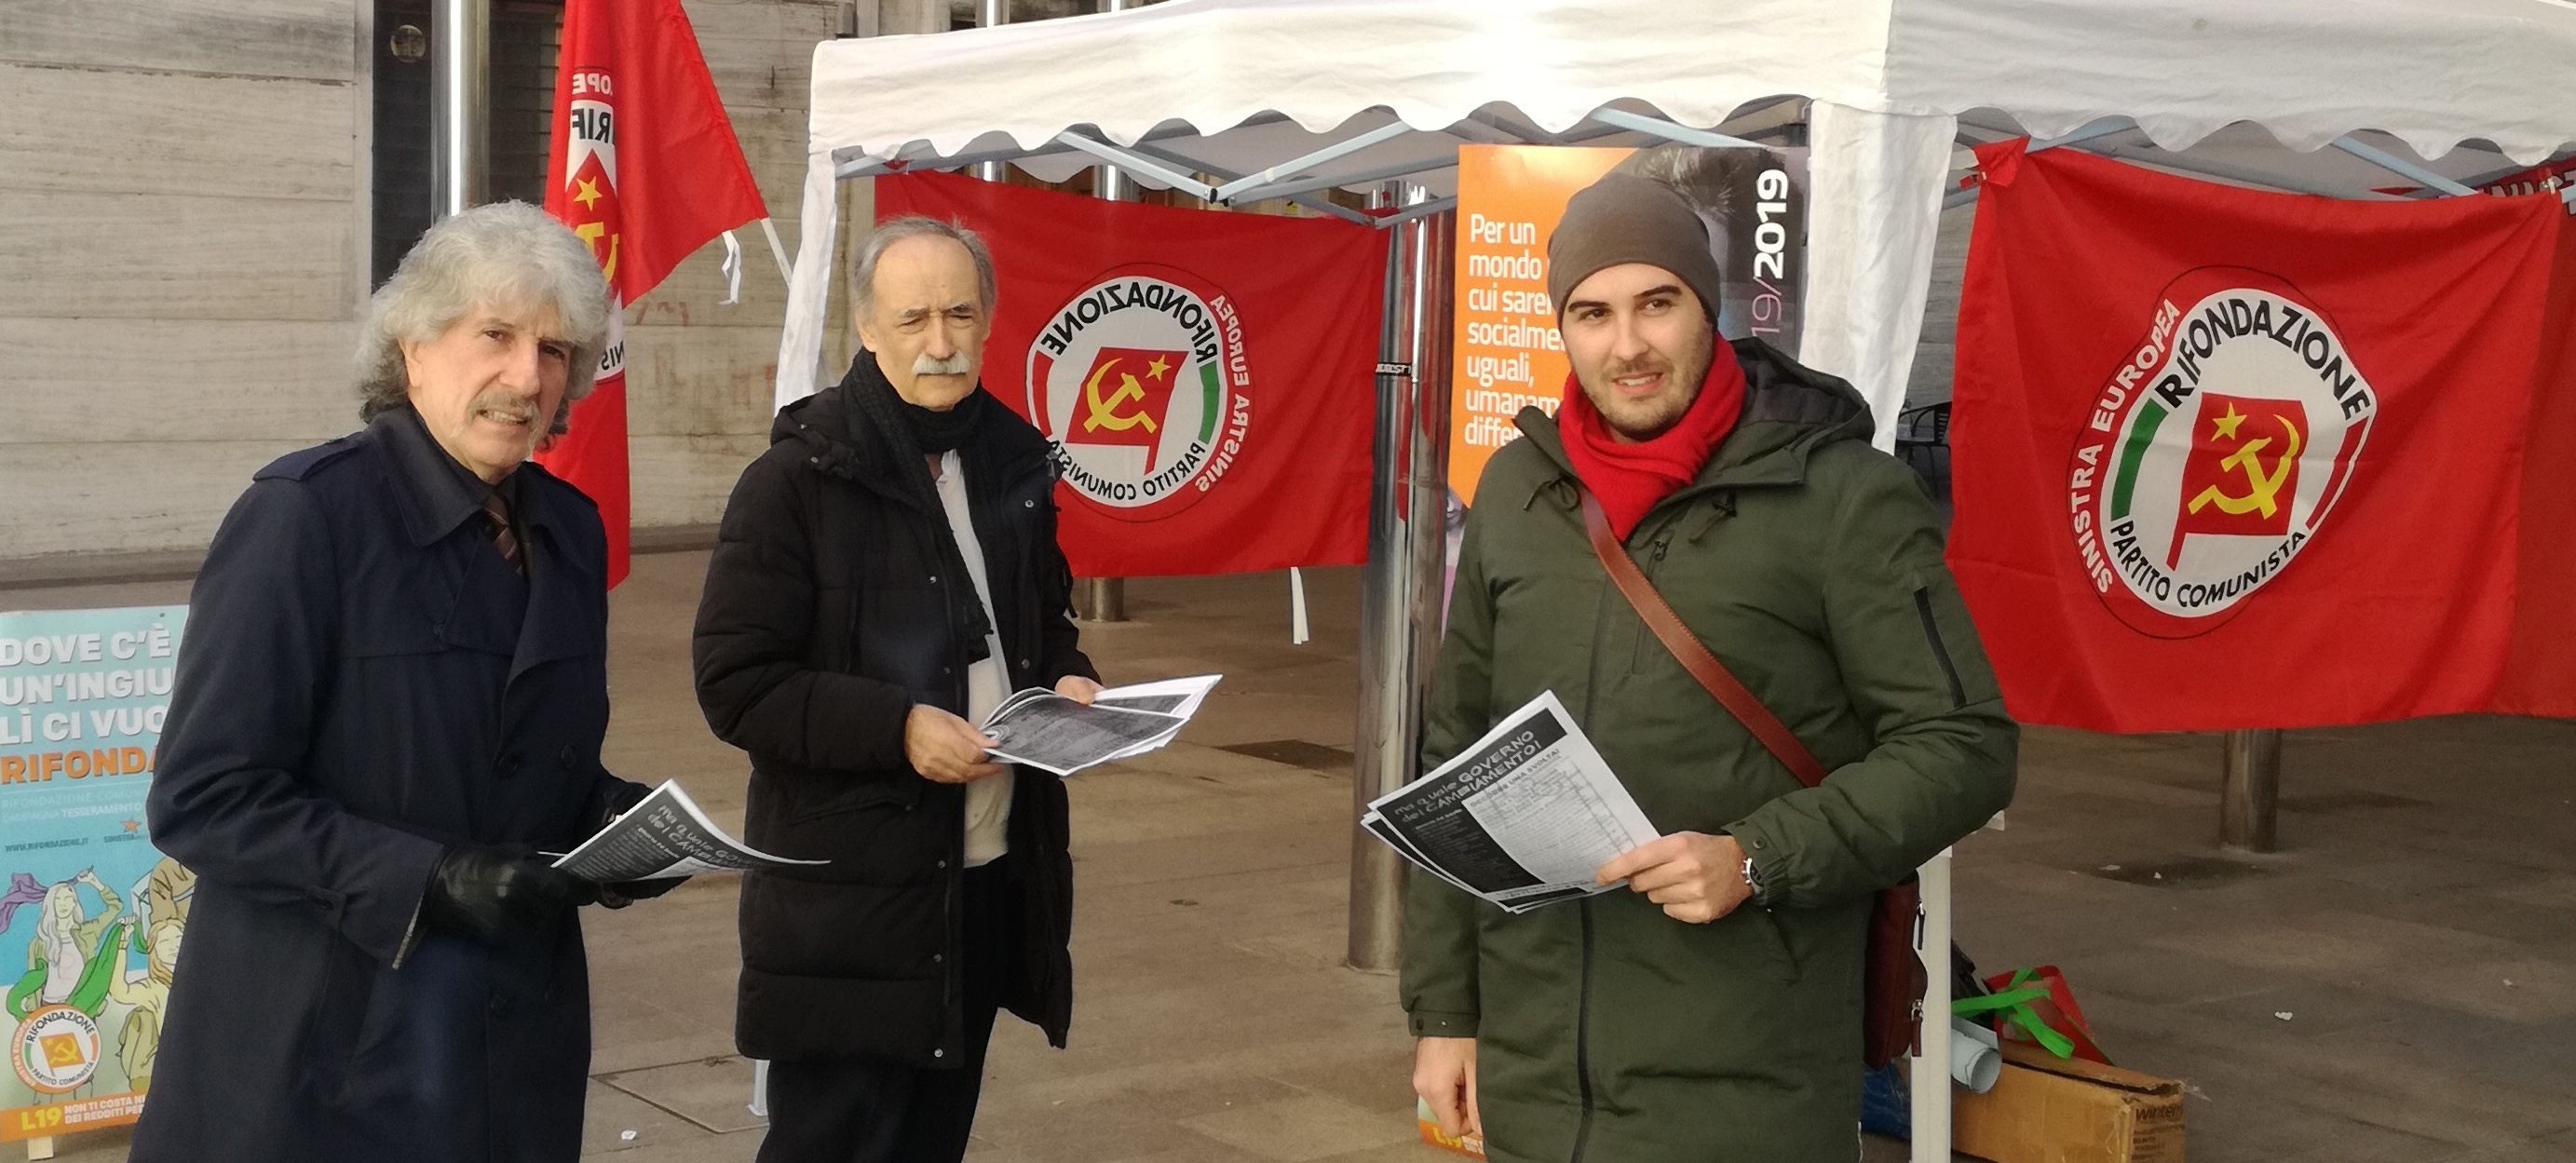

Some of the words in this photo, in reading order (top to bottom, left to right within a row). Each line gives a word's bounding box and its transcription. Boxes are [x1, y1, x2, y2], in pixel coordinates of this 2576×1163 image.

[1471, 213, 1506, 244] Per
[1509, 222, 1536, 245] un
[1469, 249, 1542, 279] mondo
[1469, 281, 1498, 311] cui
[1501, 291, 1552, 315] sare
[1467, 317, 1566, 351] socialme
[1467, 352, 1534, 387] uguali,
[2091, 298, 2181, 433] EUROPEA
[2154, 298, 2371, 421] RIFONDAZIONE
[2070, 443, 2113, 593] SINISTRA
[2110, 521, 2170, 601] PARTITO
[2176, 531, 2306, 608] COMUNISTA
[0, 633, 102, 667] DOVE
[110, 623, 171, 660] C'È
[43, 711, 82, 741] CI
[1458, 730, 1534, 783] GOVERNO
[1426, 739, 1542, 813] CAMBIAMENTO!
[61, 803, 142, 818] TESSERAMENTO
[26, 1011, 95, 1043] RIFONDAZIONE
[32, 1068, 57, 1085] PARTITO
[59, 1062, 94, 1086] COMUNISTA
[21, 1106, 62, 1130] L19
[64, 1102, 87, 1115] NON
[88, 1102, 98, 1110] TI
[99, 1096, 132, 1109] COSTA
[64, 1113, 82, 1124] DEI
[83, 1107, 124, 1121] REDDITI
